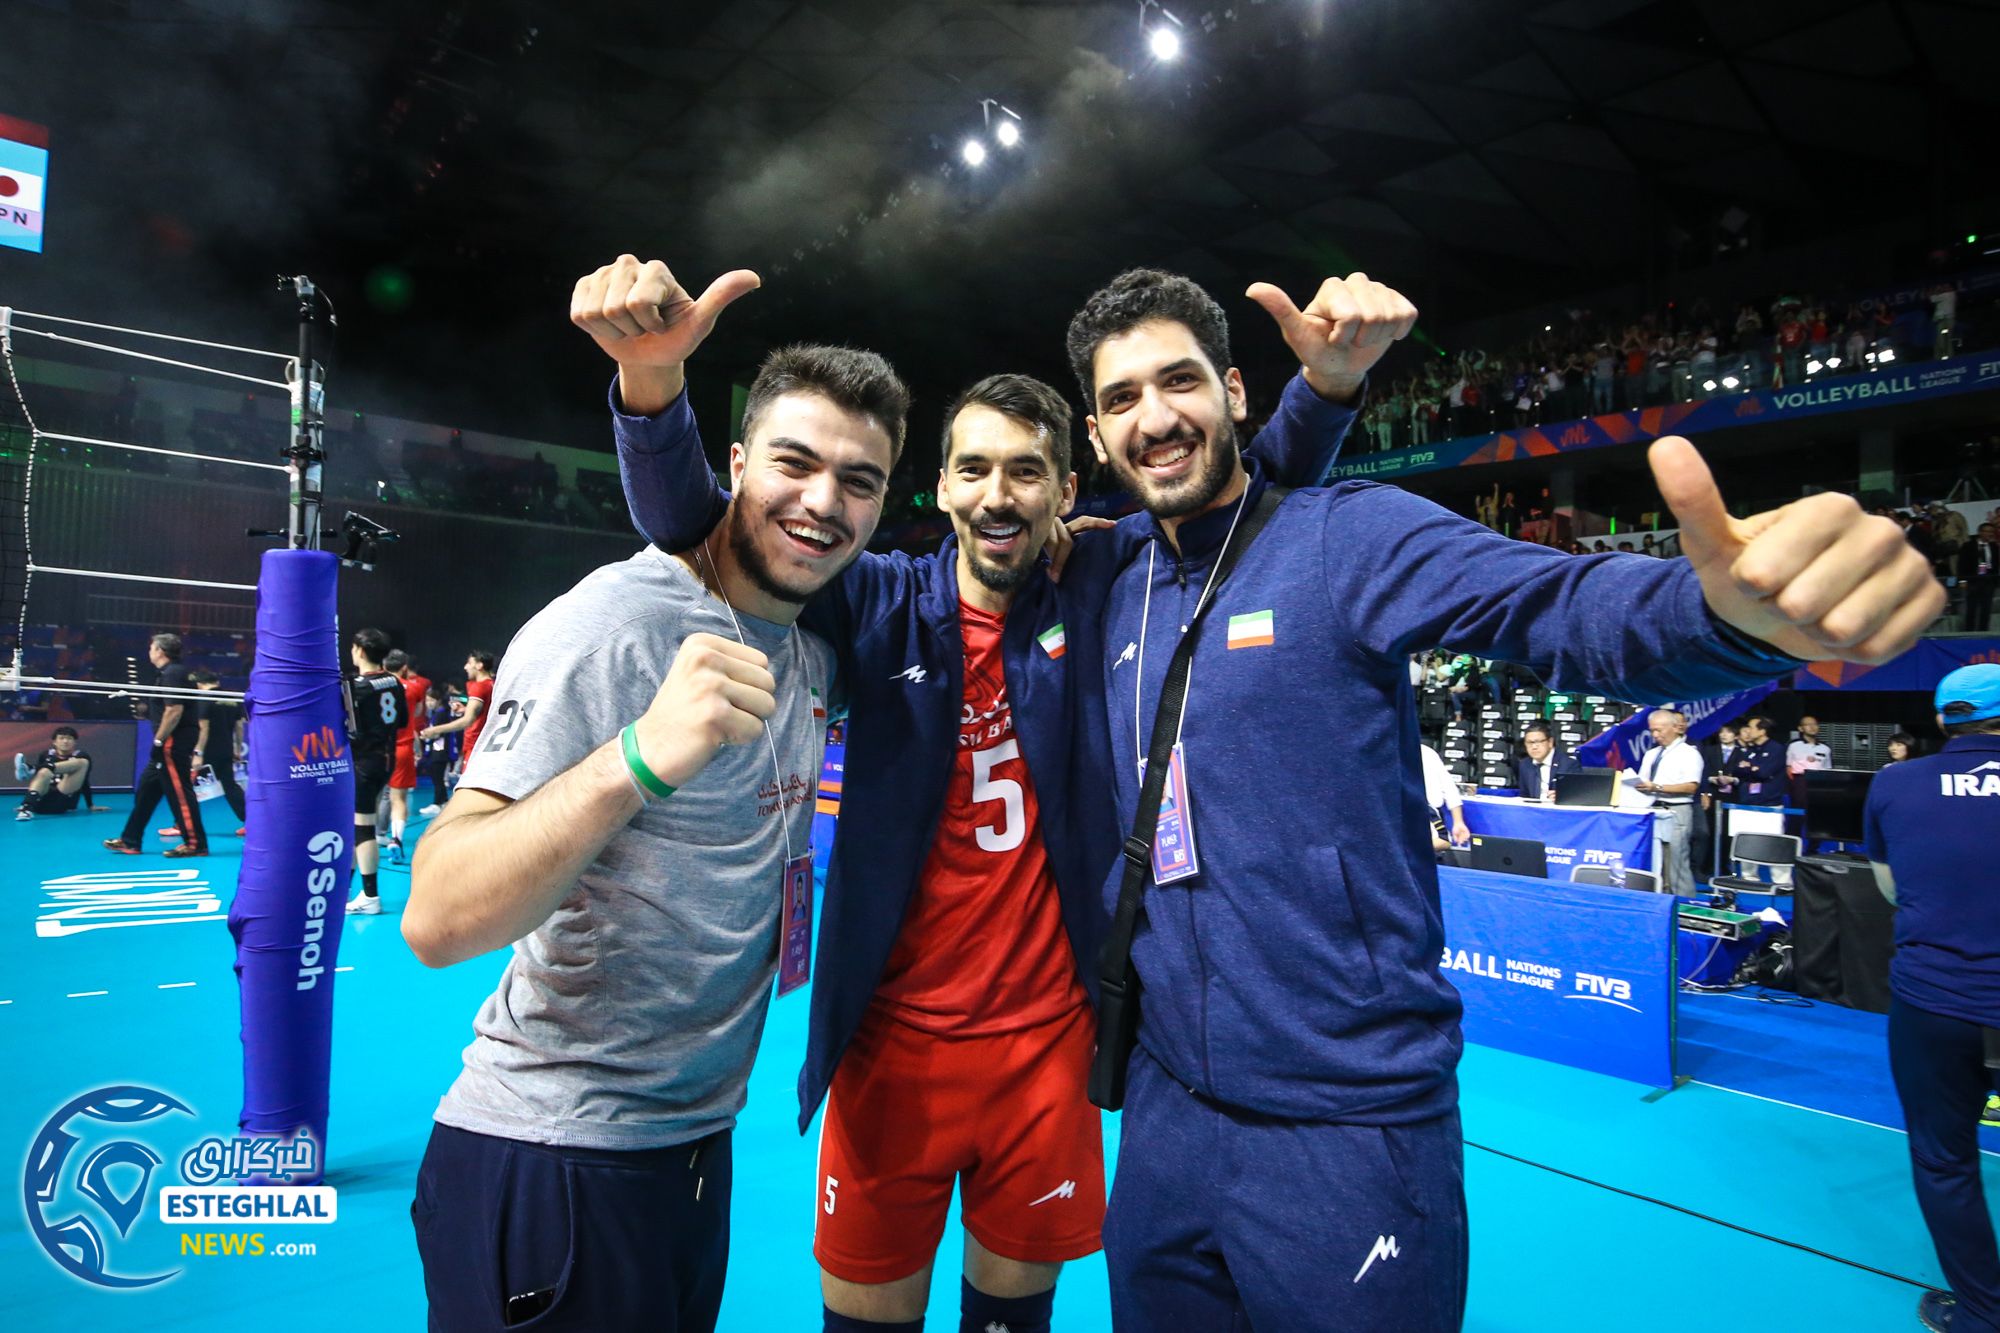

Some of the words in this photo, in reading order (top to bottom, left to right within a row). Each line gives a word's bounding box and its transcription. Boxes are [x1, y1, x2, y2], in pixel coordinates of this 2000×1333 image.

[1773, 376, 1917, 409] VOLLEYBALL
[380, 692, 398, 724] 8
[482, 699, 537, 752] 21
[289, 760, 349, 773] VOLLEYBALL
[289, 769, 326, 779] NATIONS
[327, 766, 350, 776] LEAGUE
[971, 738, 1026, 852] 5
[35, 869, 230, 938] TOKYO
[297, 867, 336, 991] Senoh
[1506, 959, 1562, 979] NATIONS
[1506, 971, 1555, 991] LEAGUE
[824, 1175, 839, 1215] 5
